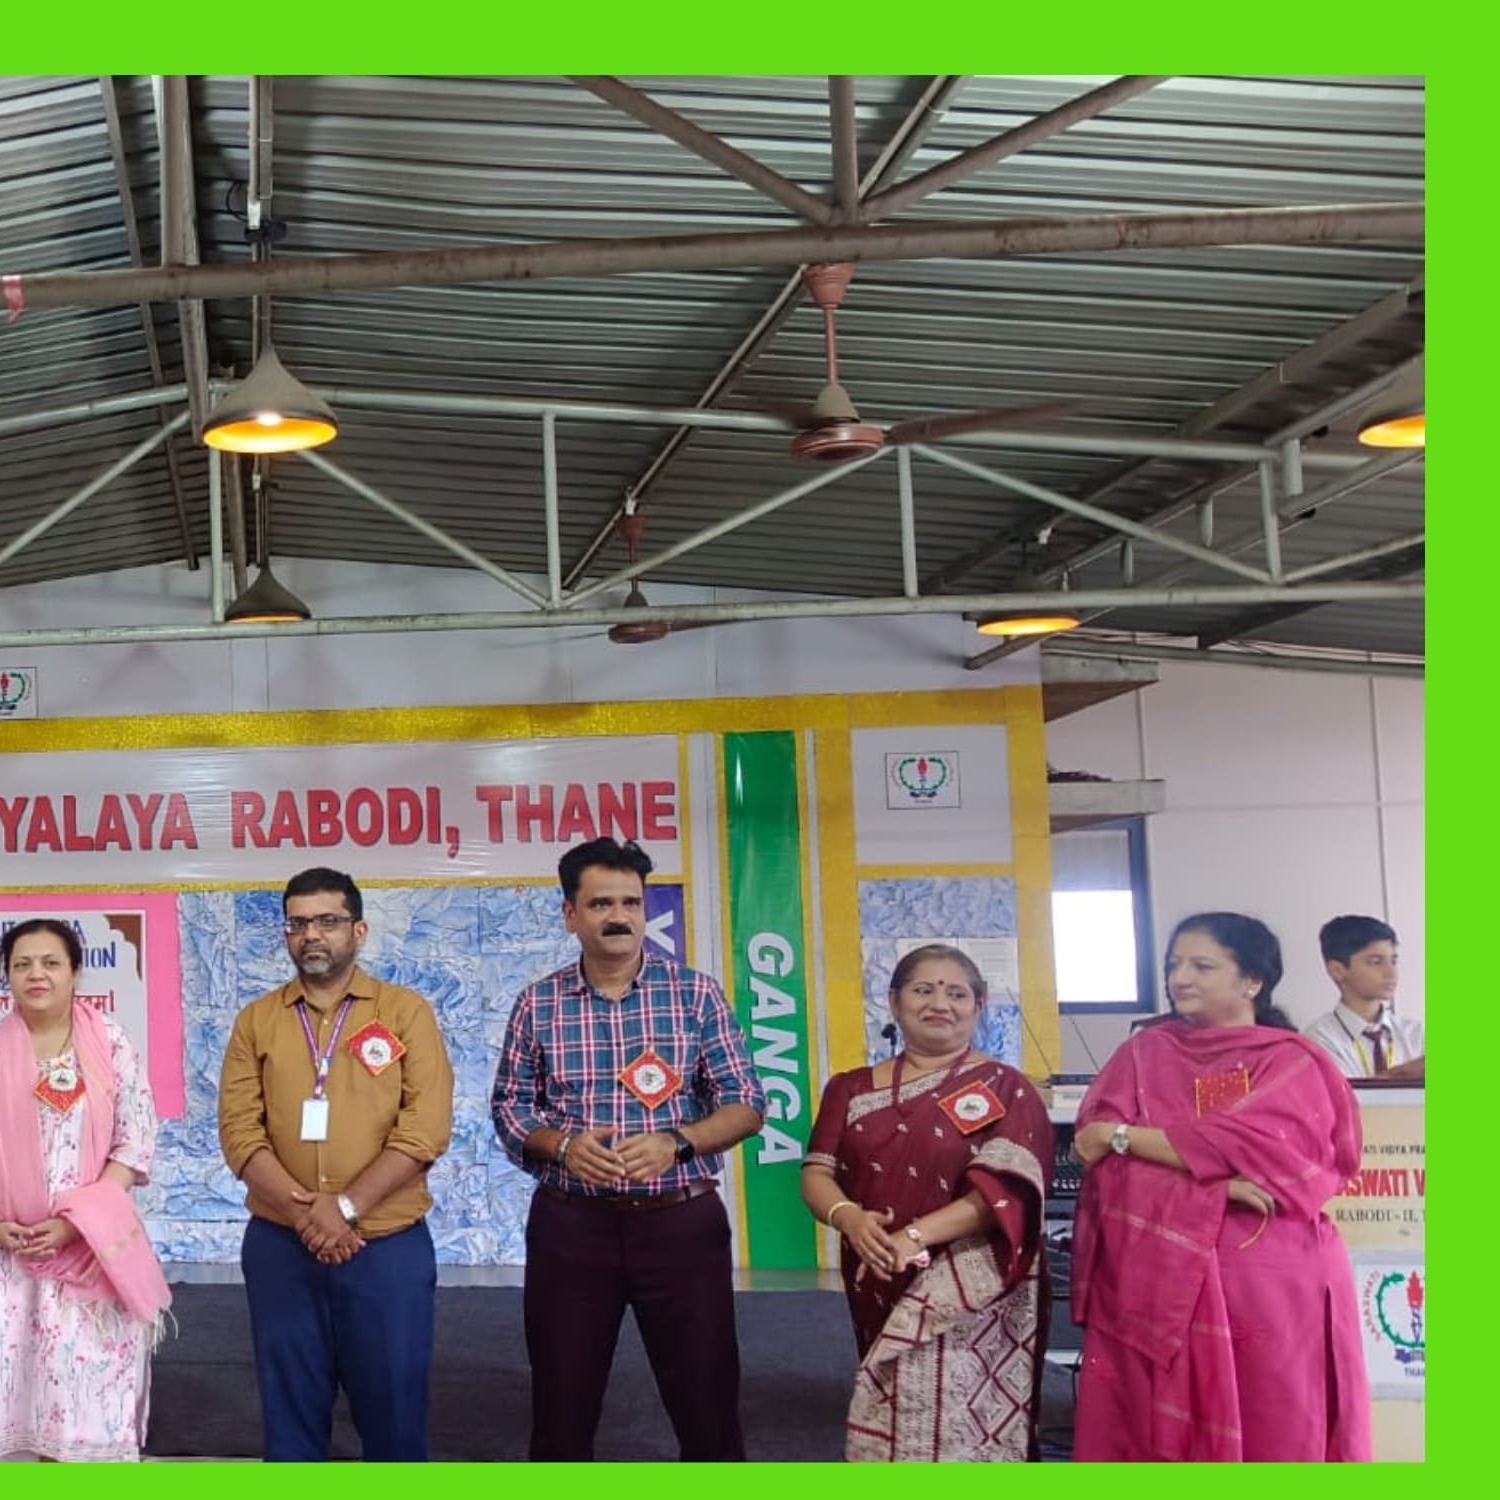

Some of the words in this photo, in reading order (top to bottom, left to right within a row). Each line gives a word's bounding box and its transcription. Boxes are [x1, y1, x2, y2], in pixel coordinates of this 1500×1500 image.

[230, 786, 460, 859] RABODI,
[475, 780, 679, 844] THANE
[747, 931, 803, 1166] GANGA
